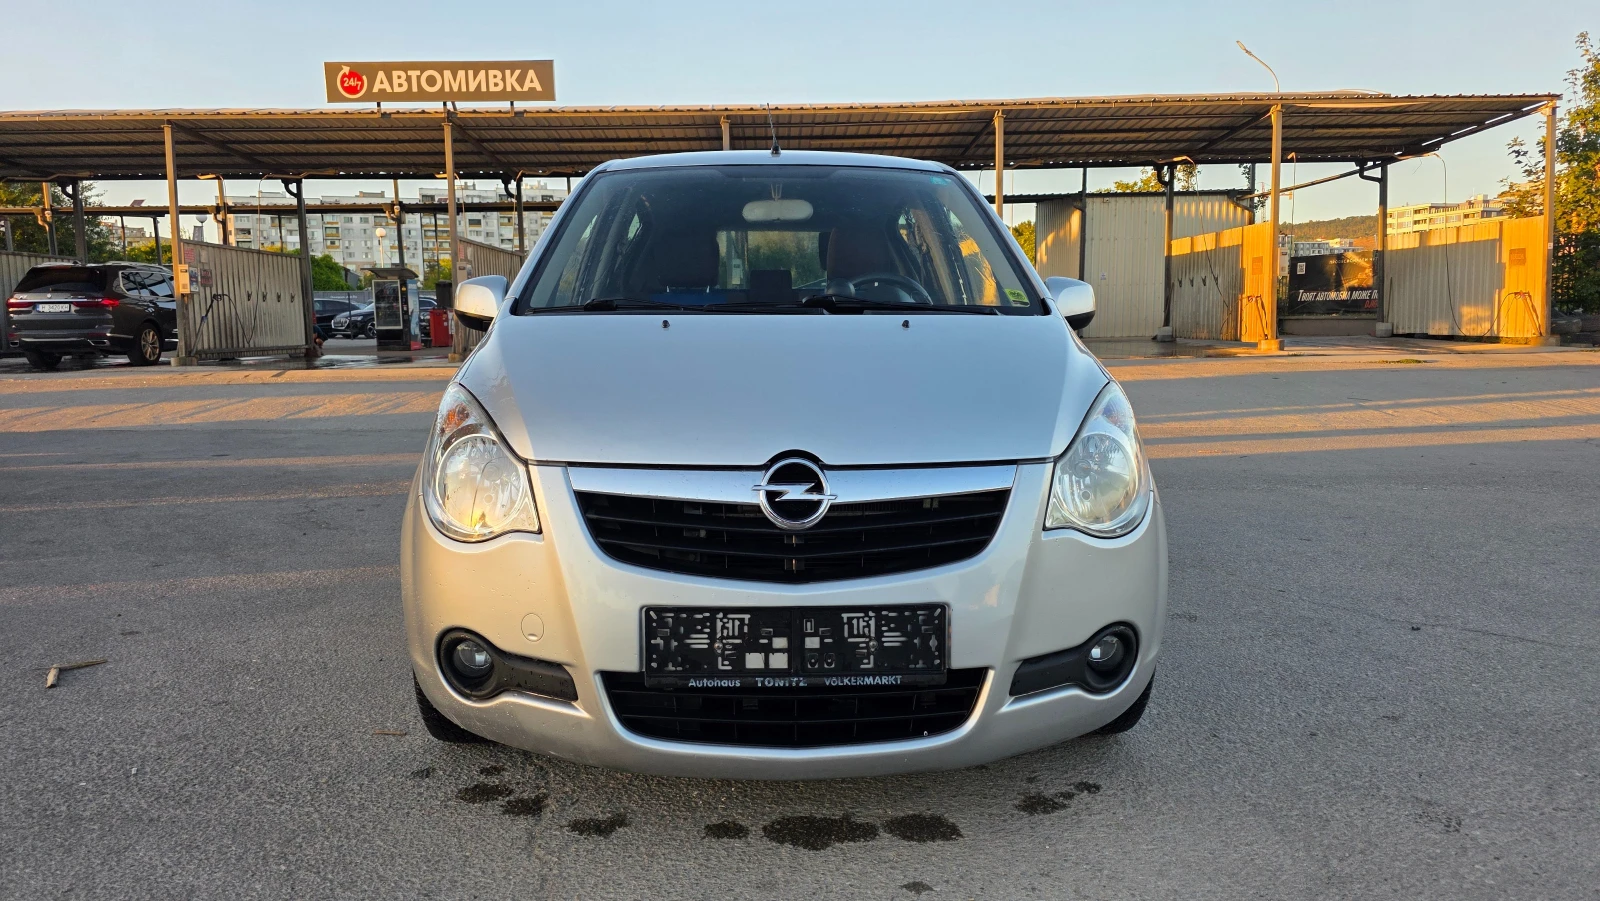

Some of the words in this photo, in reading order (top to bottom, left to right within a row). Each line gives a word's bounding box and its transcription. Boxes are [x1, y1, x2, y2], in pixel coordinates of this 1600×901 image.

[343, 77, 361, 90] 24/7
[372, 69, 543, 93] АВТОМИВКА
[688, 677, 740, 687] Autohaus
[755, 677, 808, 687] TONITZ
[824, 675, 903, 686] VÖLKERMARKT
